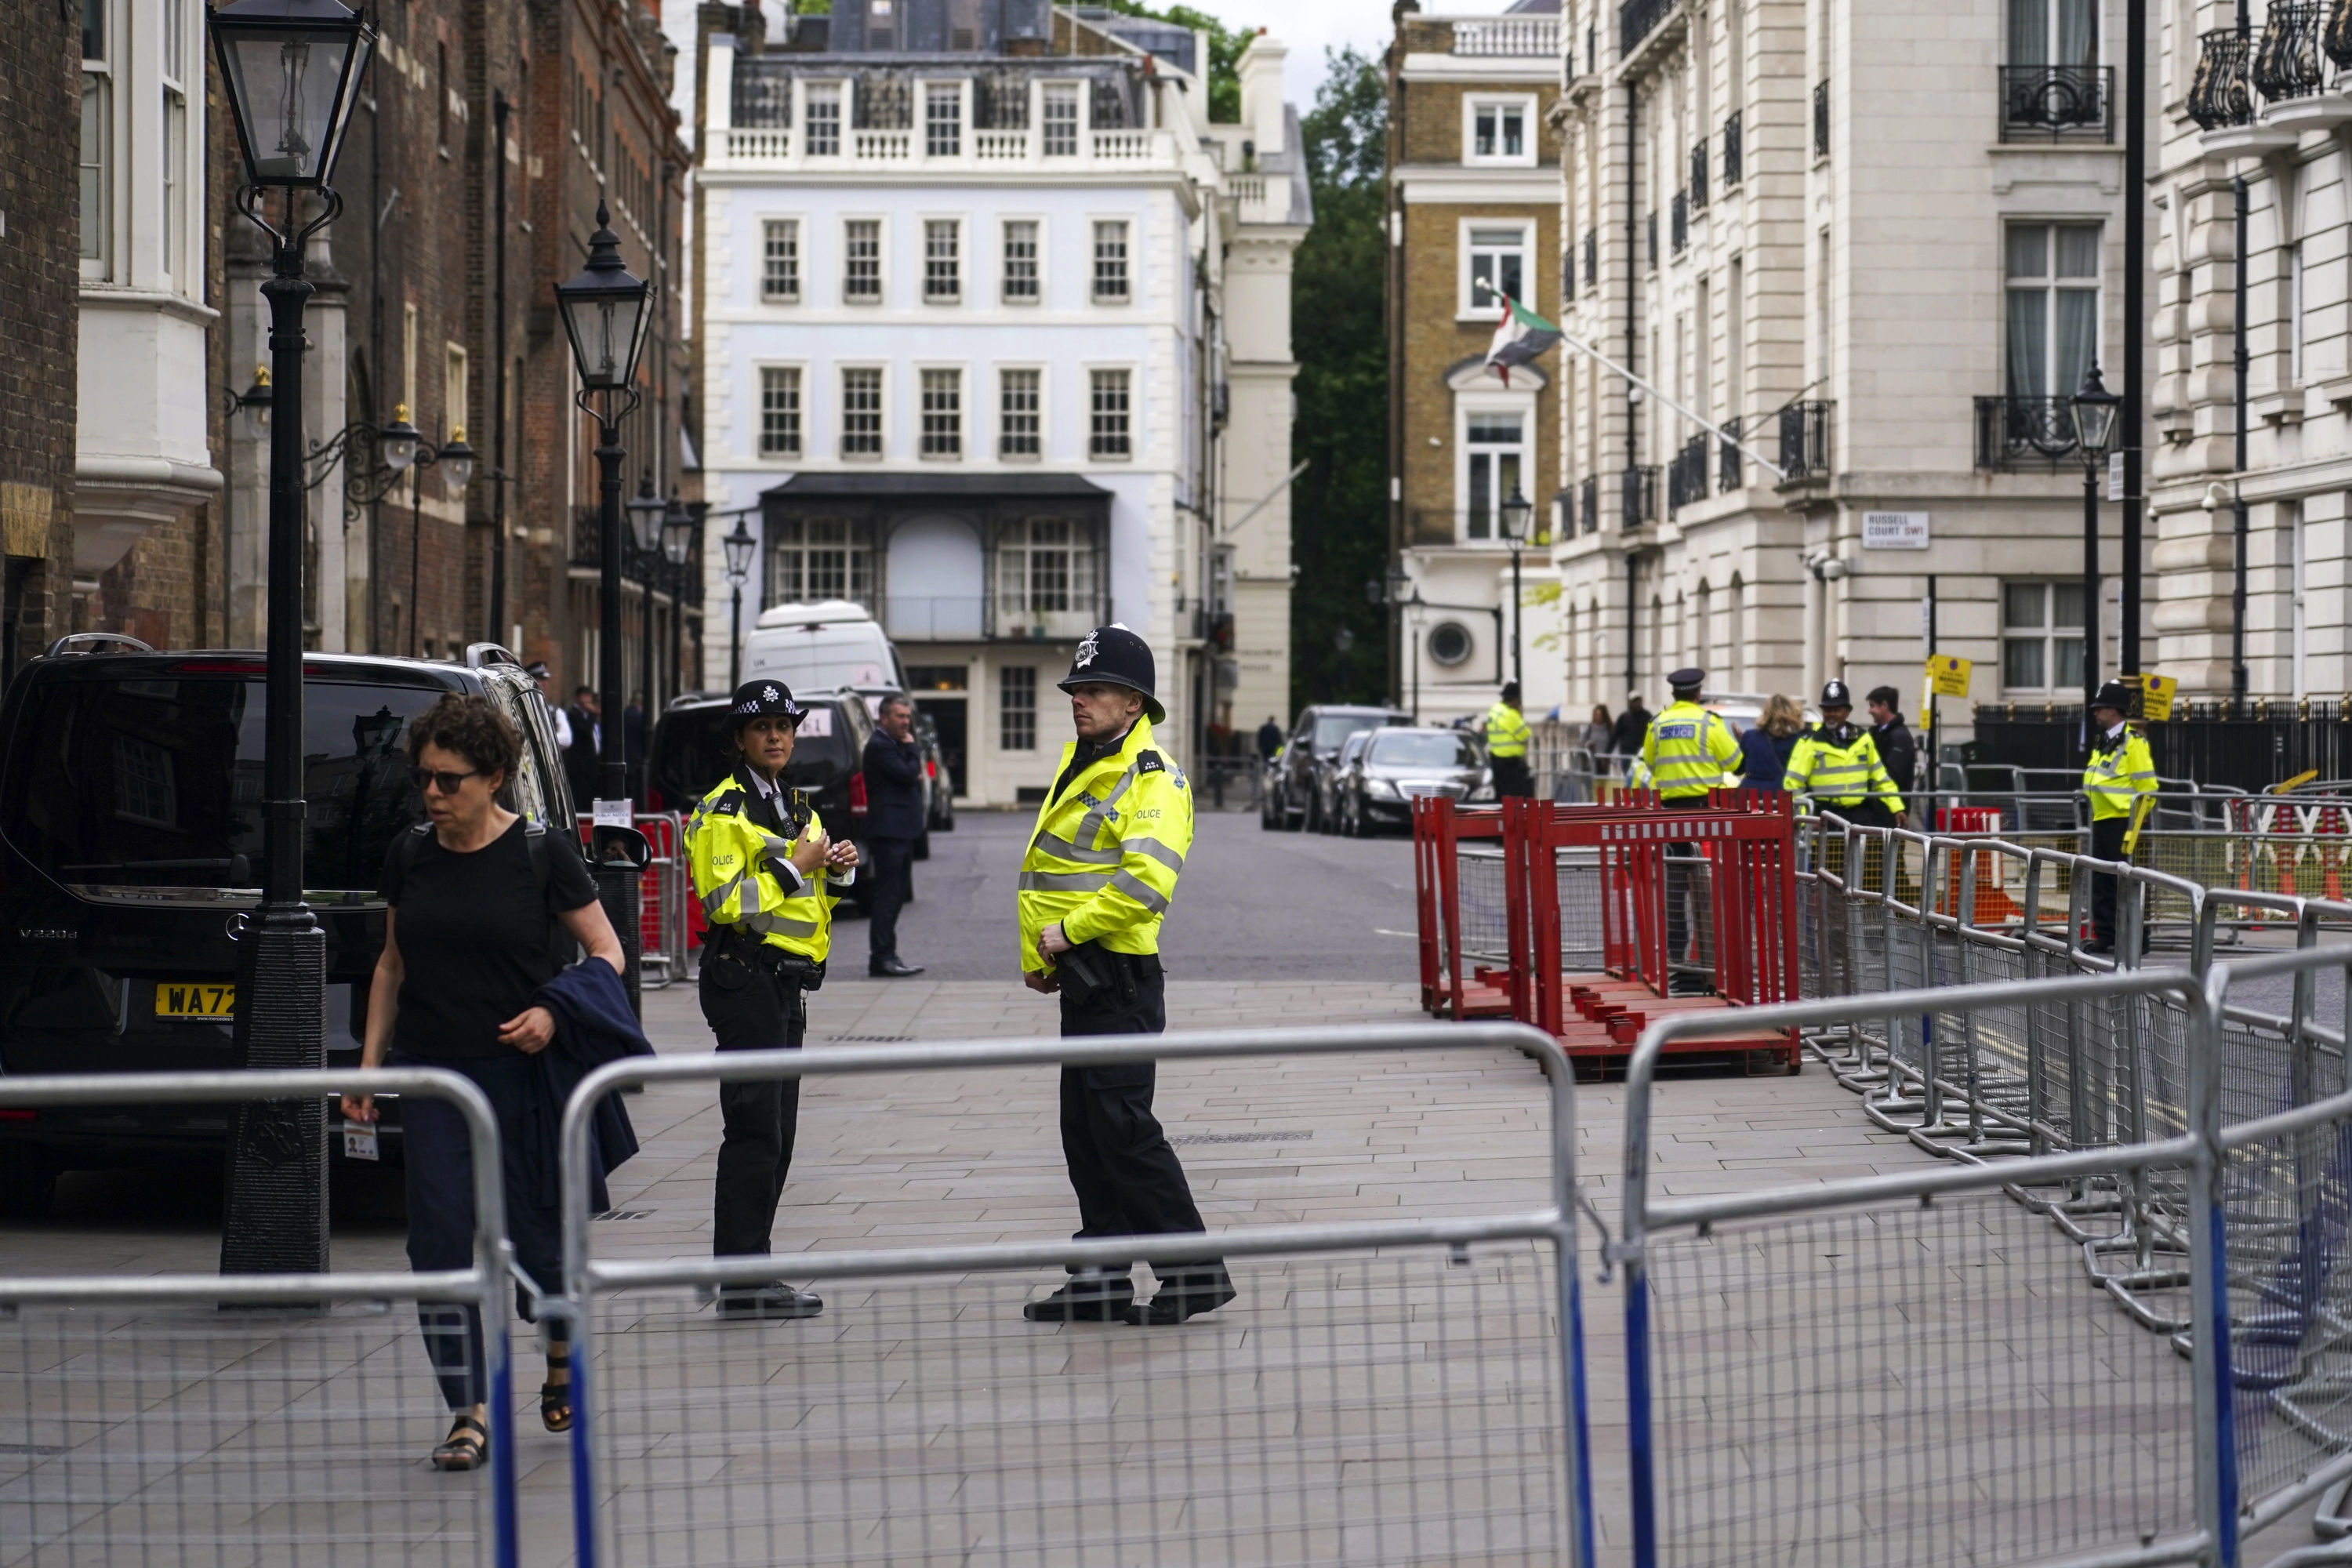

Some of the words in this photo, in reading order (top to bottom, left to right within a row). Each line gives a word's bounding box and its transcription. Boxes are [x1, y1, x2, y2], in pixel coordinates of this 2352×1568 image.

[1868, 514, 1907, 524] RUSSELL
[1868, 526, 1899, 536] COURT
[1904, 526, 1923, 536] SW1
[753, 659, 765, 667] UK
[1939, 676, 1965, 685] WARNING
[1661, 728, 1694, 738] POLICE
[712, 854, 734, 866] OLICE
